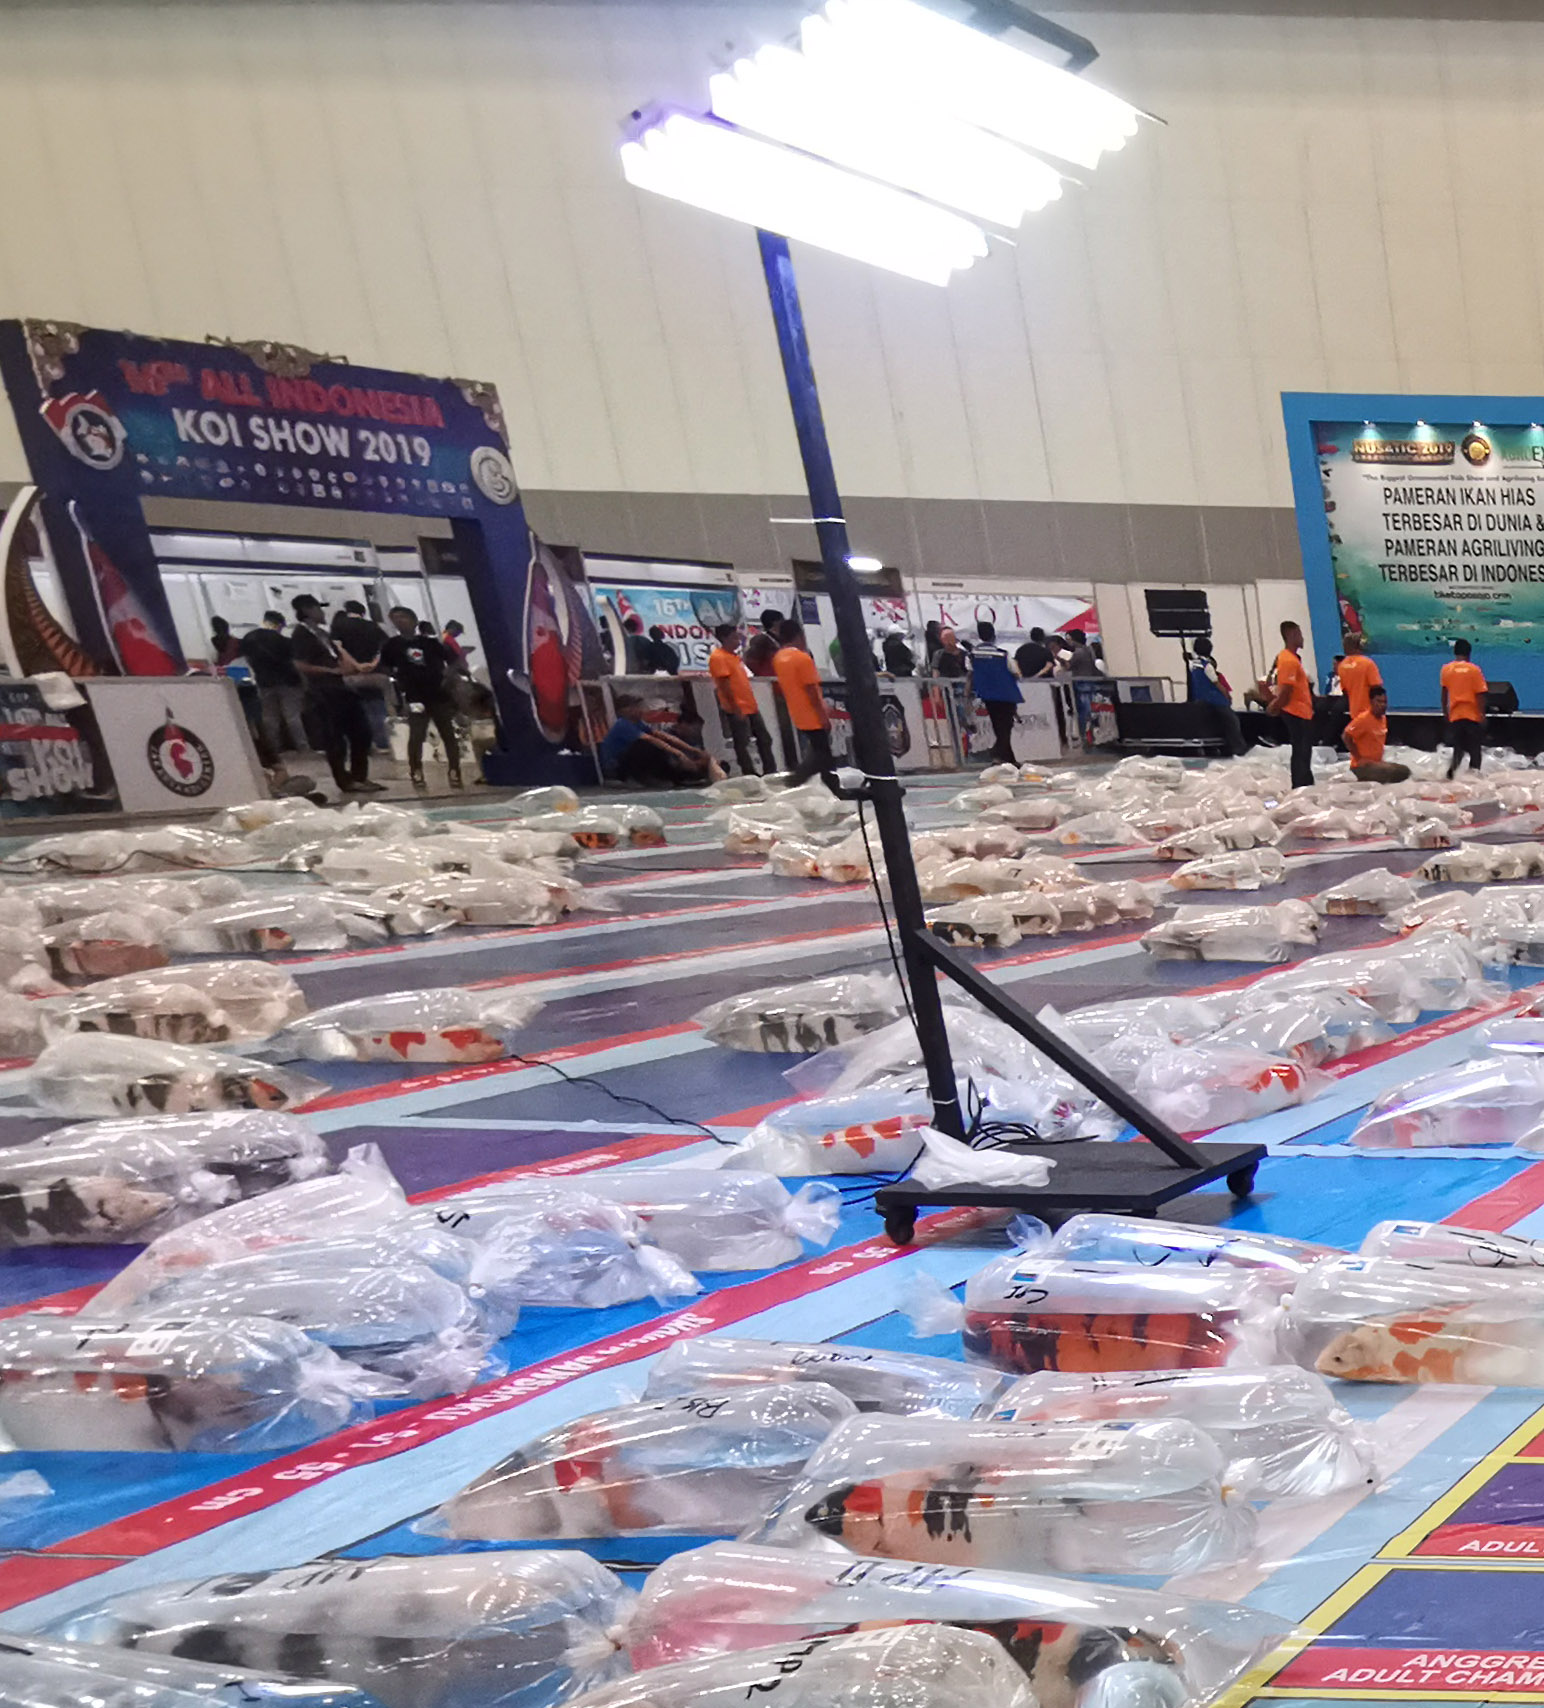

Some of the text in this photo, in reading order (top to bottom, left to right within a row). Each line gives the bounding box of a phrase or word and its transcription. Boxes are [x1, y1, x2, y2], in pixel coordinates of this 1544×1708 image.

[172, 407, 432, 467] KOI SHOW 2019
[1383, 487, 1537, 507] PAMERAN IKAN HIAS
[1382, 513, 1464, 532] TERBESAR
[1467, 514, 1482, 532] DI
[1486, 514, 1533, 532] DUNIA
[1384, 539, 1458, 557] PAMERAN
[1378, 564, 1459, 583] TERBESAR
[1463, 564, 1478, 583] DI
[937, 603, 1024, 628] KOI
[7, 763, 94, 801] SHOW
[423, 1350, 607, 1423] SANSHOKU
[274, 1458, 338, 1481] 55
[190, 1484, 262, 1511] cm
[1320, 1667, 1432, 1686] ADULT
